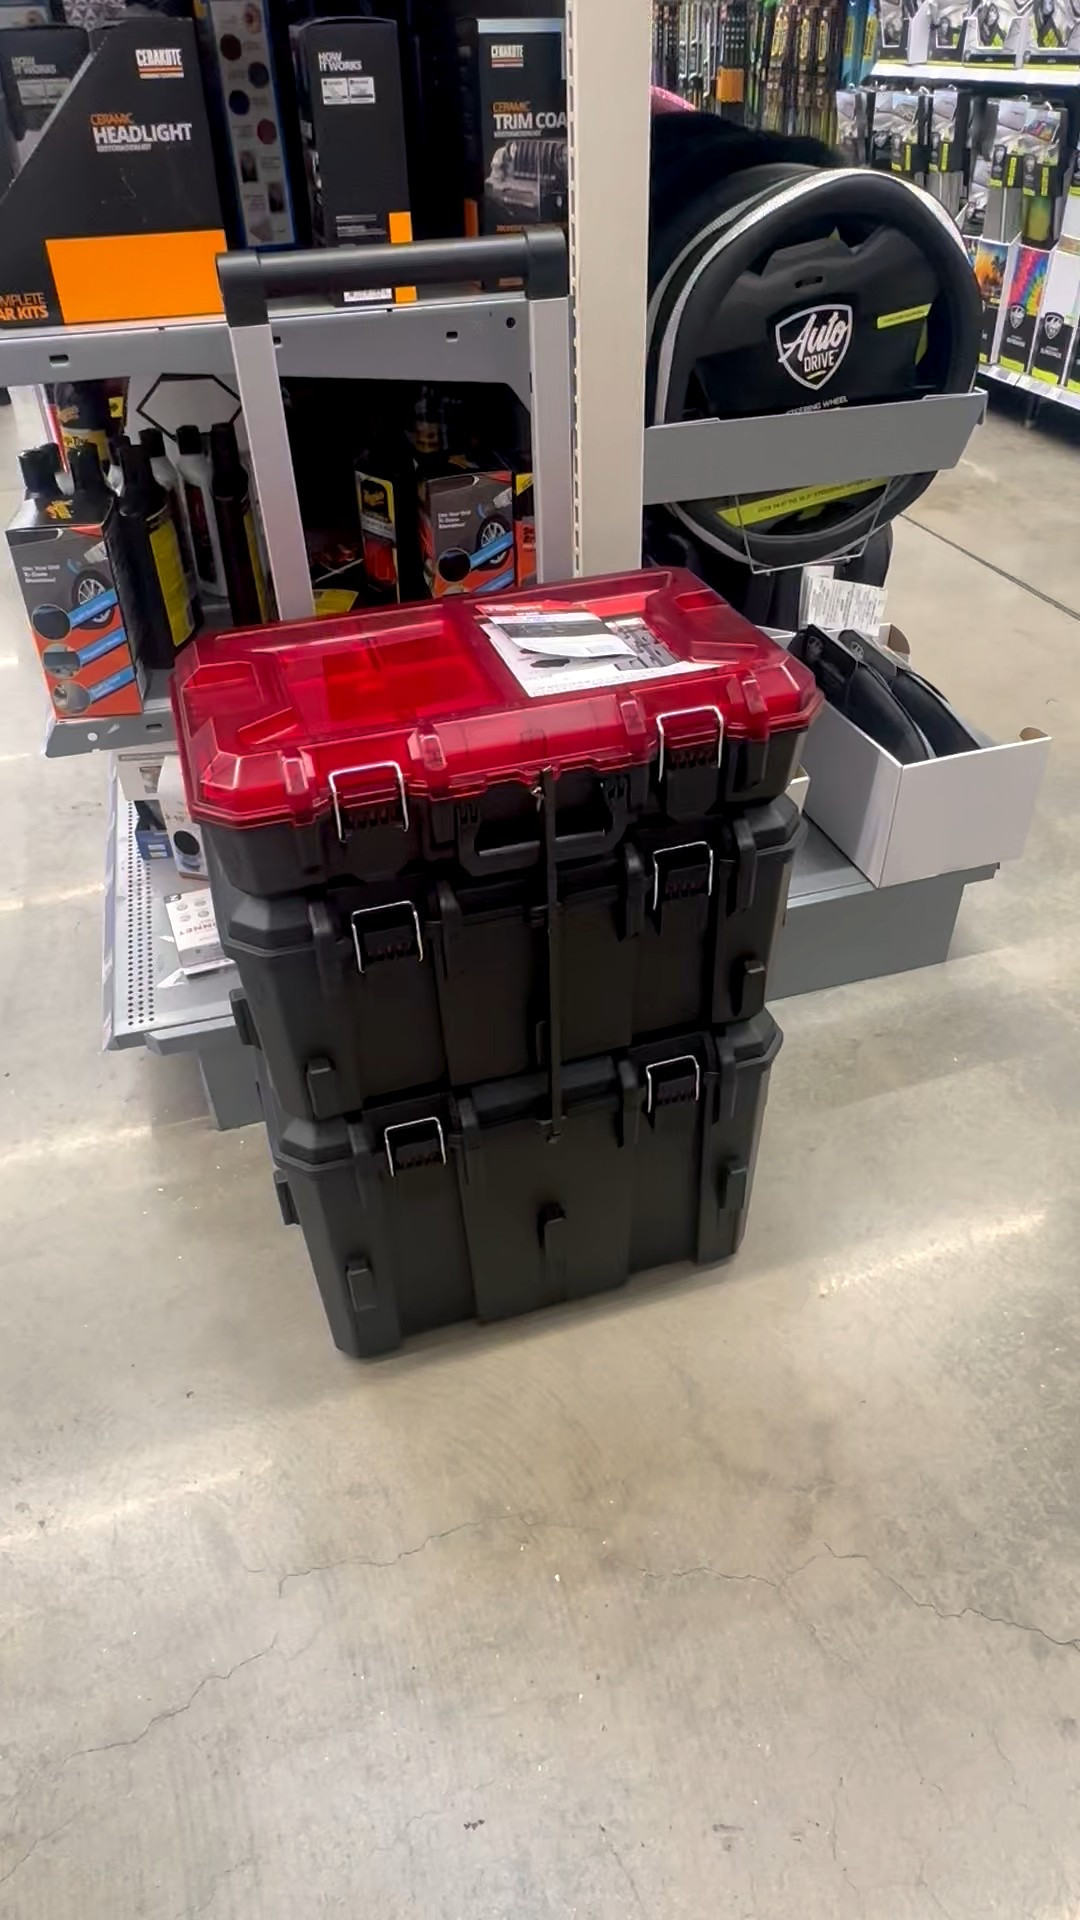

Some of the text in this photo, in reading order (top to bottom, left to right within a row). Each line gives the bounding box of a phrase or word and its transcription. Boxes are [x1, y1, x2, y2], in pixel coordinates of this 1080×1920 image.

[493, 111, 568, 130] TRIM COA
[92, 123, 192, 144] HEADLIGHT
[0, 292, 46, 307] MPLETE
[0, 305, 49, 321] AR KITS
[778, 311, 849, 362] Auto
[803, 351, 838, 372] DRIVE
